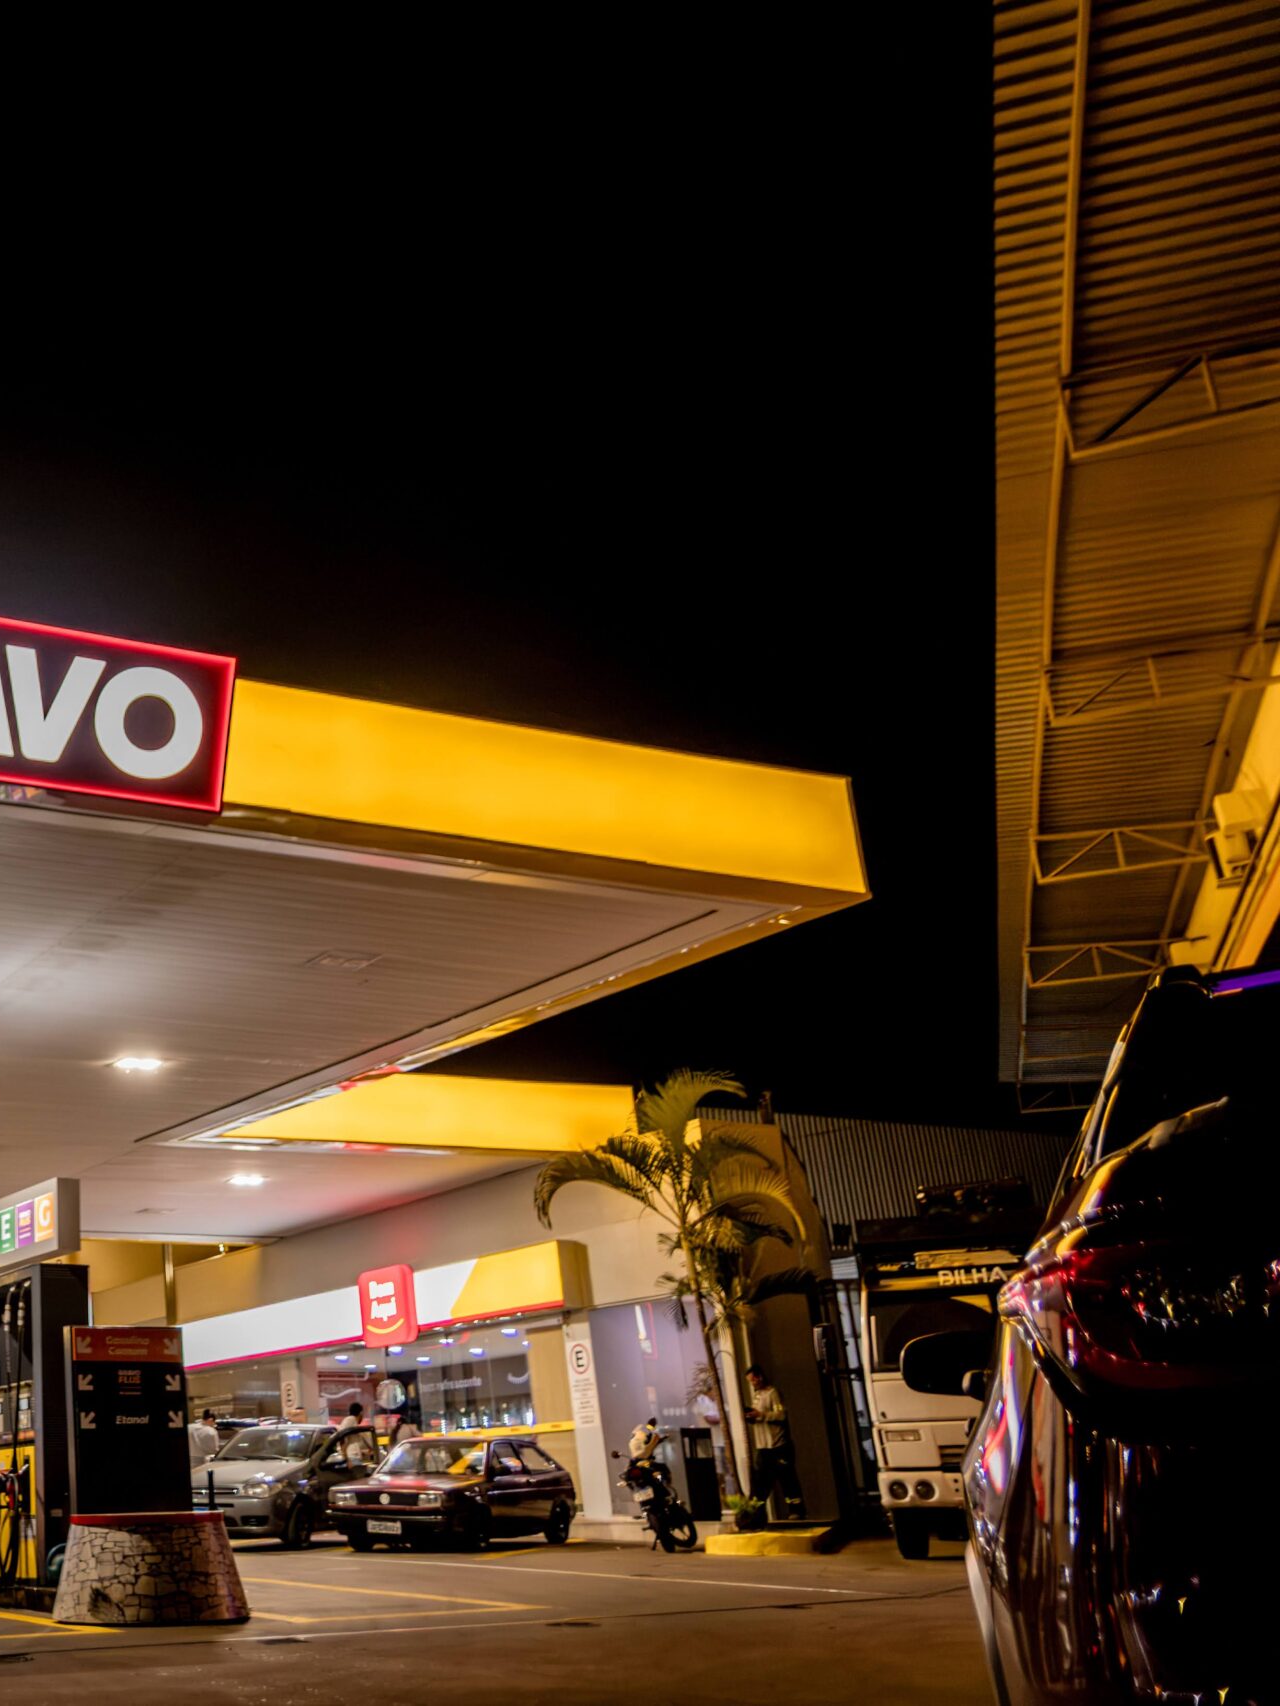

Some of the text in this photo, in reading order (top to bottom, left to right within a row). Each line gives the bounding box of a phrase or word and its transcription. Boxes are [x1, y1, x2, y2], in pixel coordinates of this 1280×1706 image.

[38, 1199, 51, 1227] G
[1, 1213, 11, 1241] E
[575, 1350, 585, 1368] E
[115, 1414, 150, 1425] Etanol
